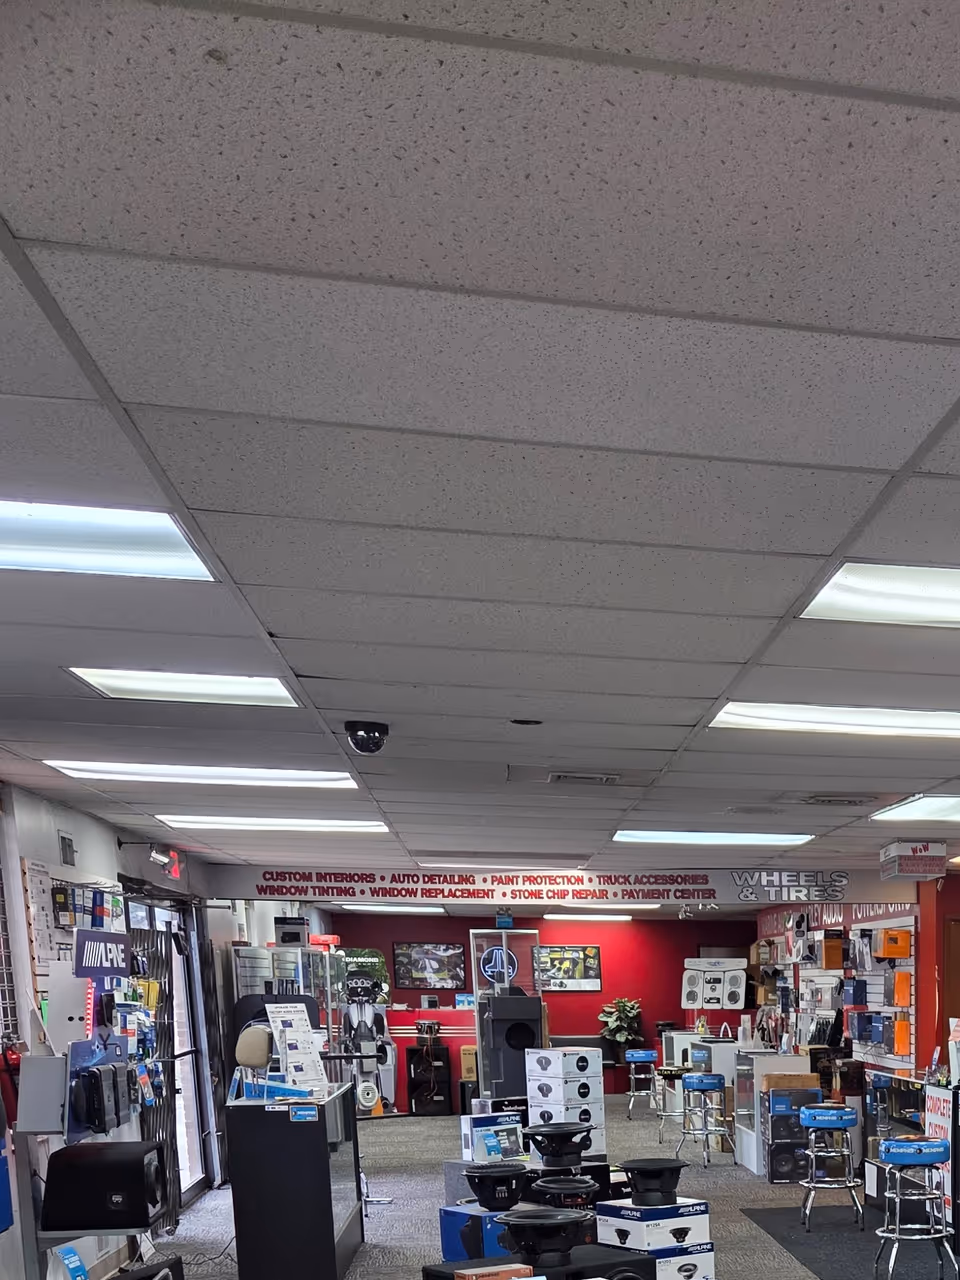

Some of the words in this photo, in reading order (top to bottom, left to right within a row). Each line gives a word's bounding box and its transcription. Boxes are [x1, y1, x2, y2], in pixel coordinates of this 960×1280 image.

[911, 842, 930, 856] WoW
[262, 870, 313, 883] CUSTOM
[315, 871, 376, 884] INTERIORS
[390, 872, 419, 885] AUTO
[422, 873, 476, 886] DETAILING
[490, 874, 520, 886] PAINT
[522, 874, 584, 886] PROTECTION
[596, 874, 632, 886] TRUCK
[633, 874, 709, 886] ACCESSORIES
[731, 871, 849, 887] WHEELS
[256, 884, 309, 897] WINDOW
[310, 885, 356, 897] TINTING
[369, 886, 418, 898] WINDOW
[420, 887, 496, 899] REPLACEMENT
[510, 888, 544, 900] STONE
[546, 888, 569, 900] CHIP
[571, 888, 609, 900] REPAIR
[621, 888, 673, 900] PAYMENT
[674, 888, 716, 900] CENTER
[738, 887, 758, 901] &
[764, 886, 845, 901] TIRES
[822, 903, 844, 925] AUDIO
[83, 940, 126, 968] ALPINE
[926, 1096, 951, 1119] COMPLETE
[620, 1209, 641, 1218] ALPINE
[678, 1204, 706, 1214] ALPINE
[687, 1243, 712, 1252] ALPINE
